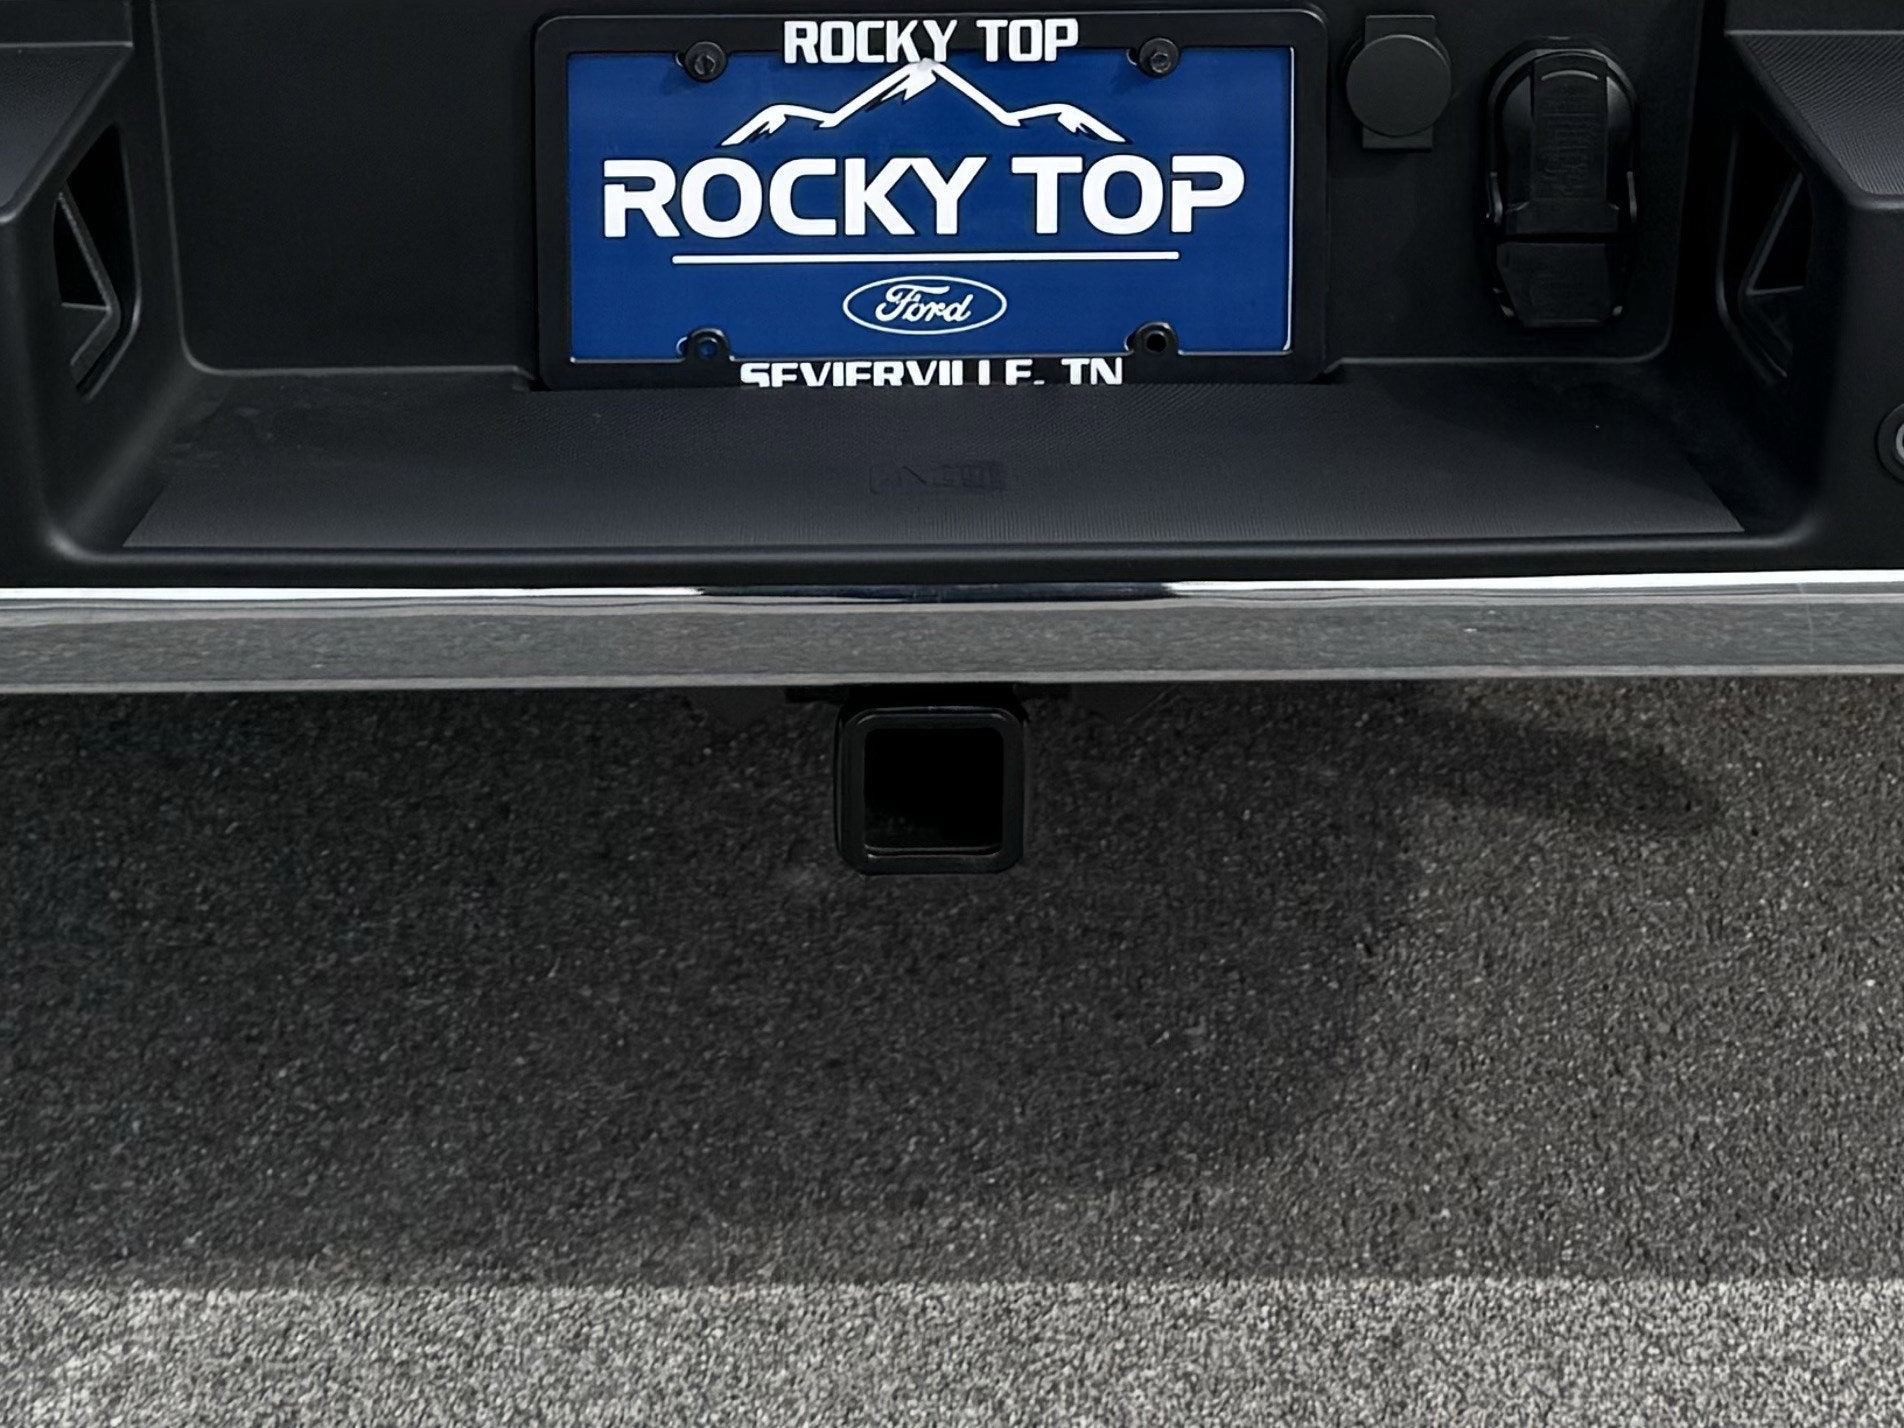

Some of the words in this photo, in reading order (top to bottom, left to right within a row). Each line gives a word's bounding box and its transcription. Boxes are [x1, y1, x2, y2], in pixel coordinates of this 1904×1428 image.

[784, 19, 958, 64] ROCKY
[976, 17, 1079, 63] TOP
[603, 155, 988, 239] ROCKY
[1010, 154, 1246, 236] TOP
[875, 284, 974, 322] Ford
[1061, 357, 1124, 386] TN
